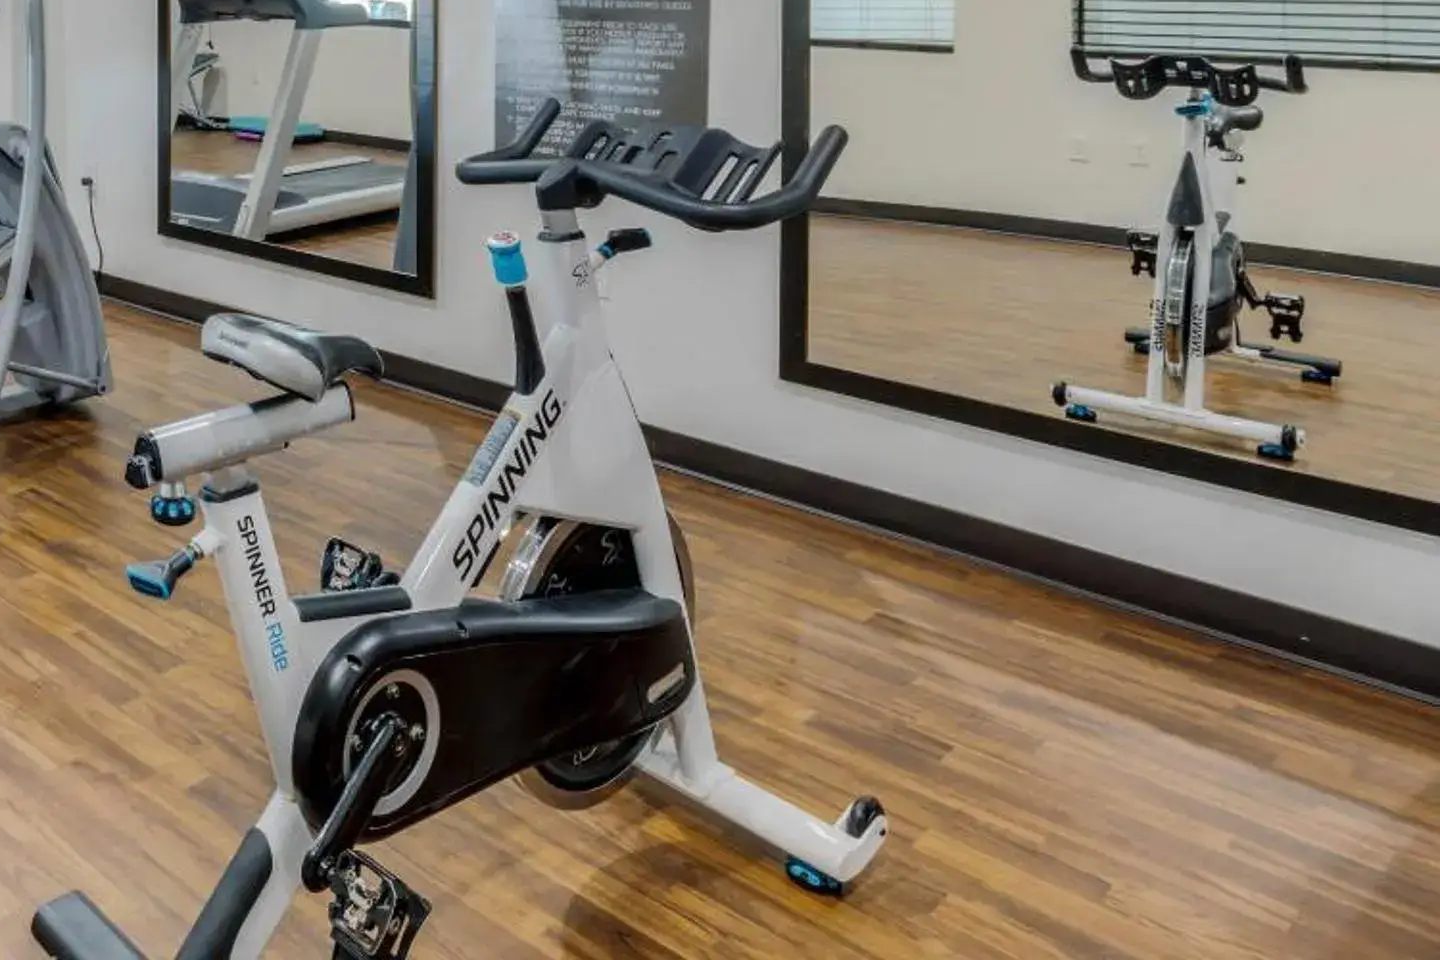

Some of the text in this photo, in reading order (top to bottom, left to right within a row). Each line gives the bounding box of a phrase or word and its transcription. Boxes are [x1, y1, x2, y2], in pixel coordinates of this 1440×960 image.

[453, 389, 561, 581] SPINNING
[236, 514, 288, 672] SPINNER Ride
